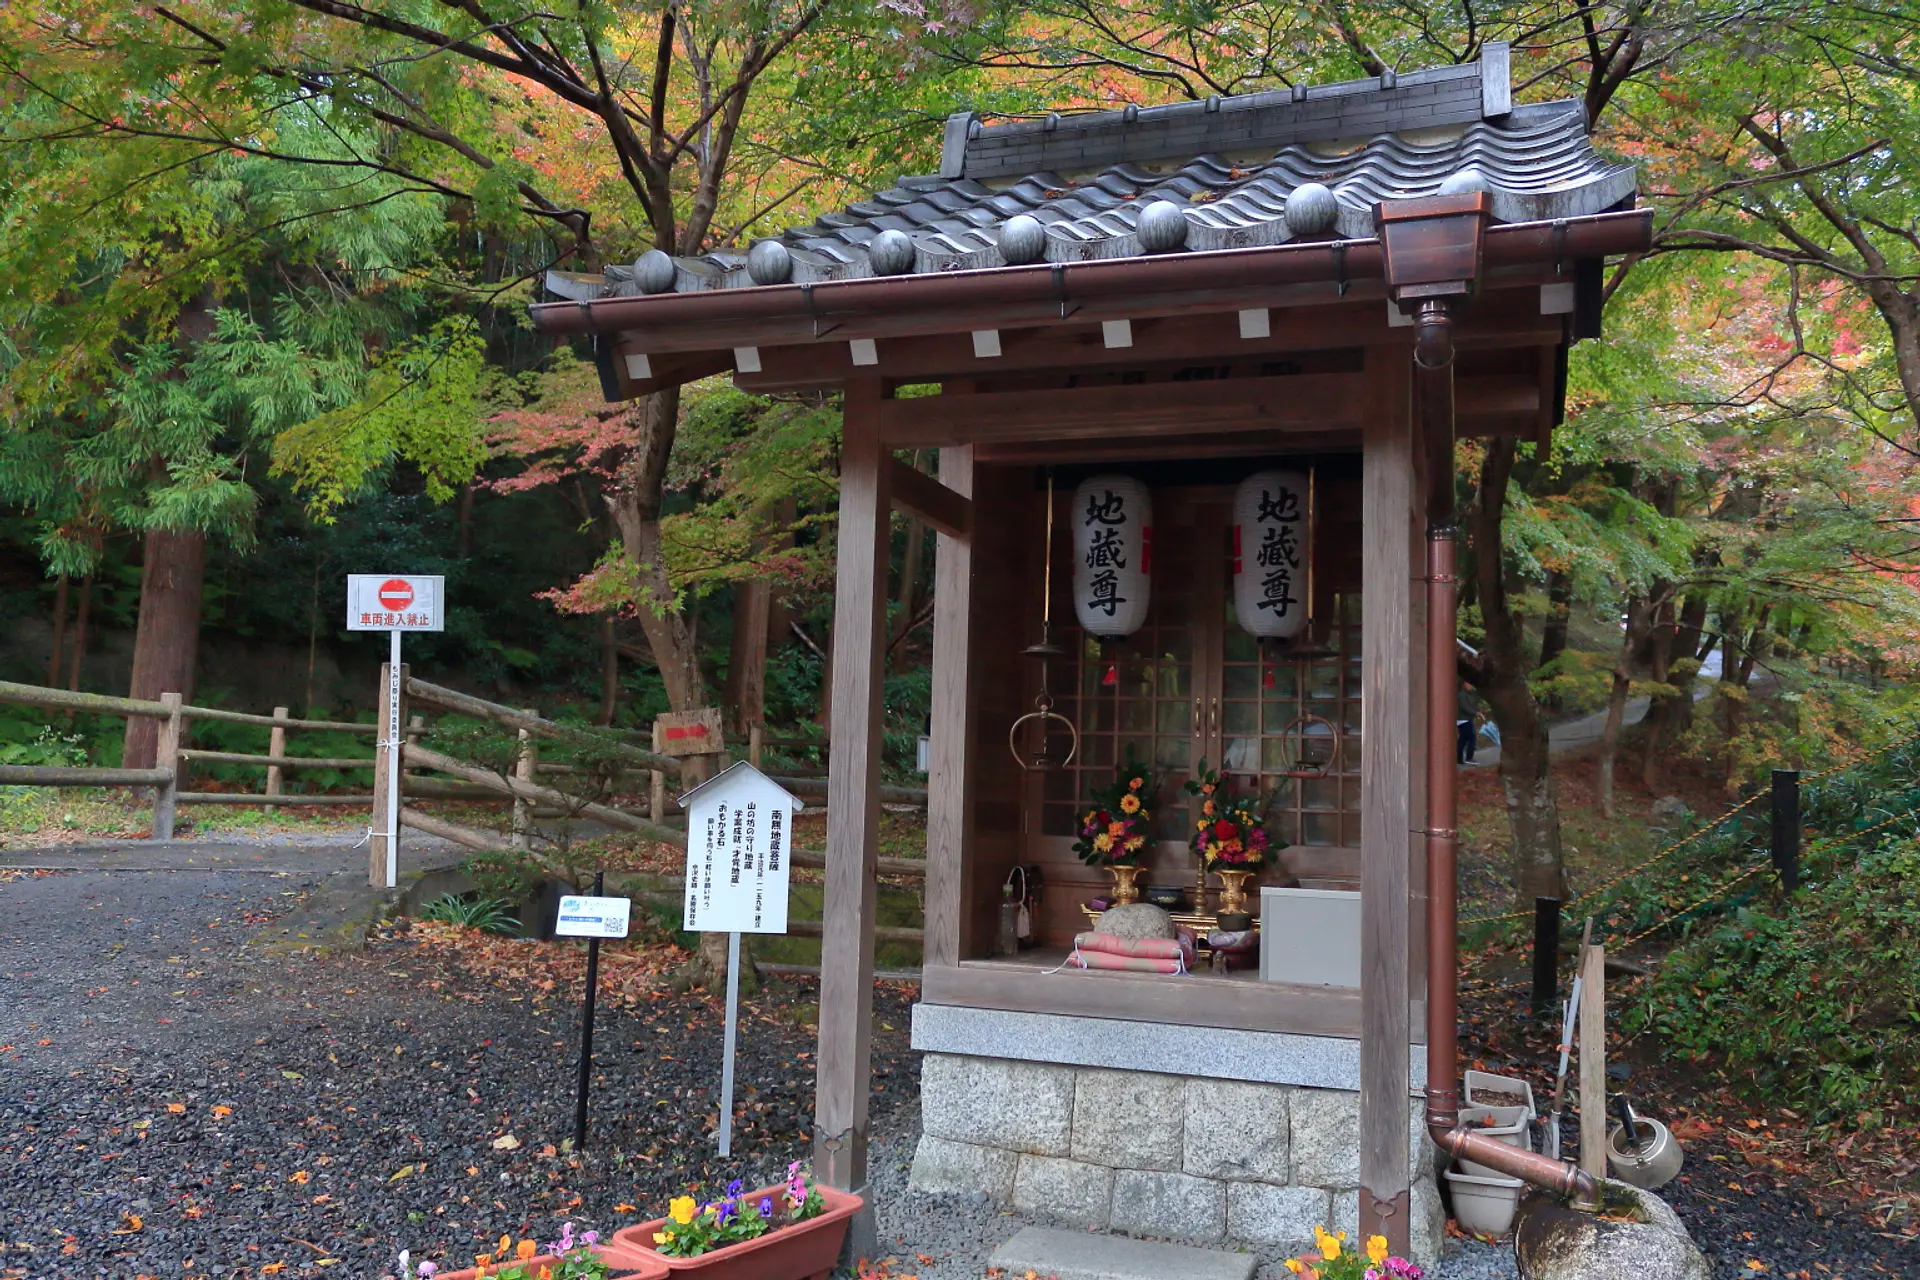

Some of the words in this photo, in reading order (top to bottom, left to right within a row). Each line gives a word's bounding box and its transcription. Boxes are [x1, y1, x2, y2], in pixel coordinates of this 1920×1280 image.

[360, 612, 429, 626] 車両進入禁止
[768, 810, 782, 871] 南無地蔵菩薩
